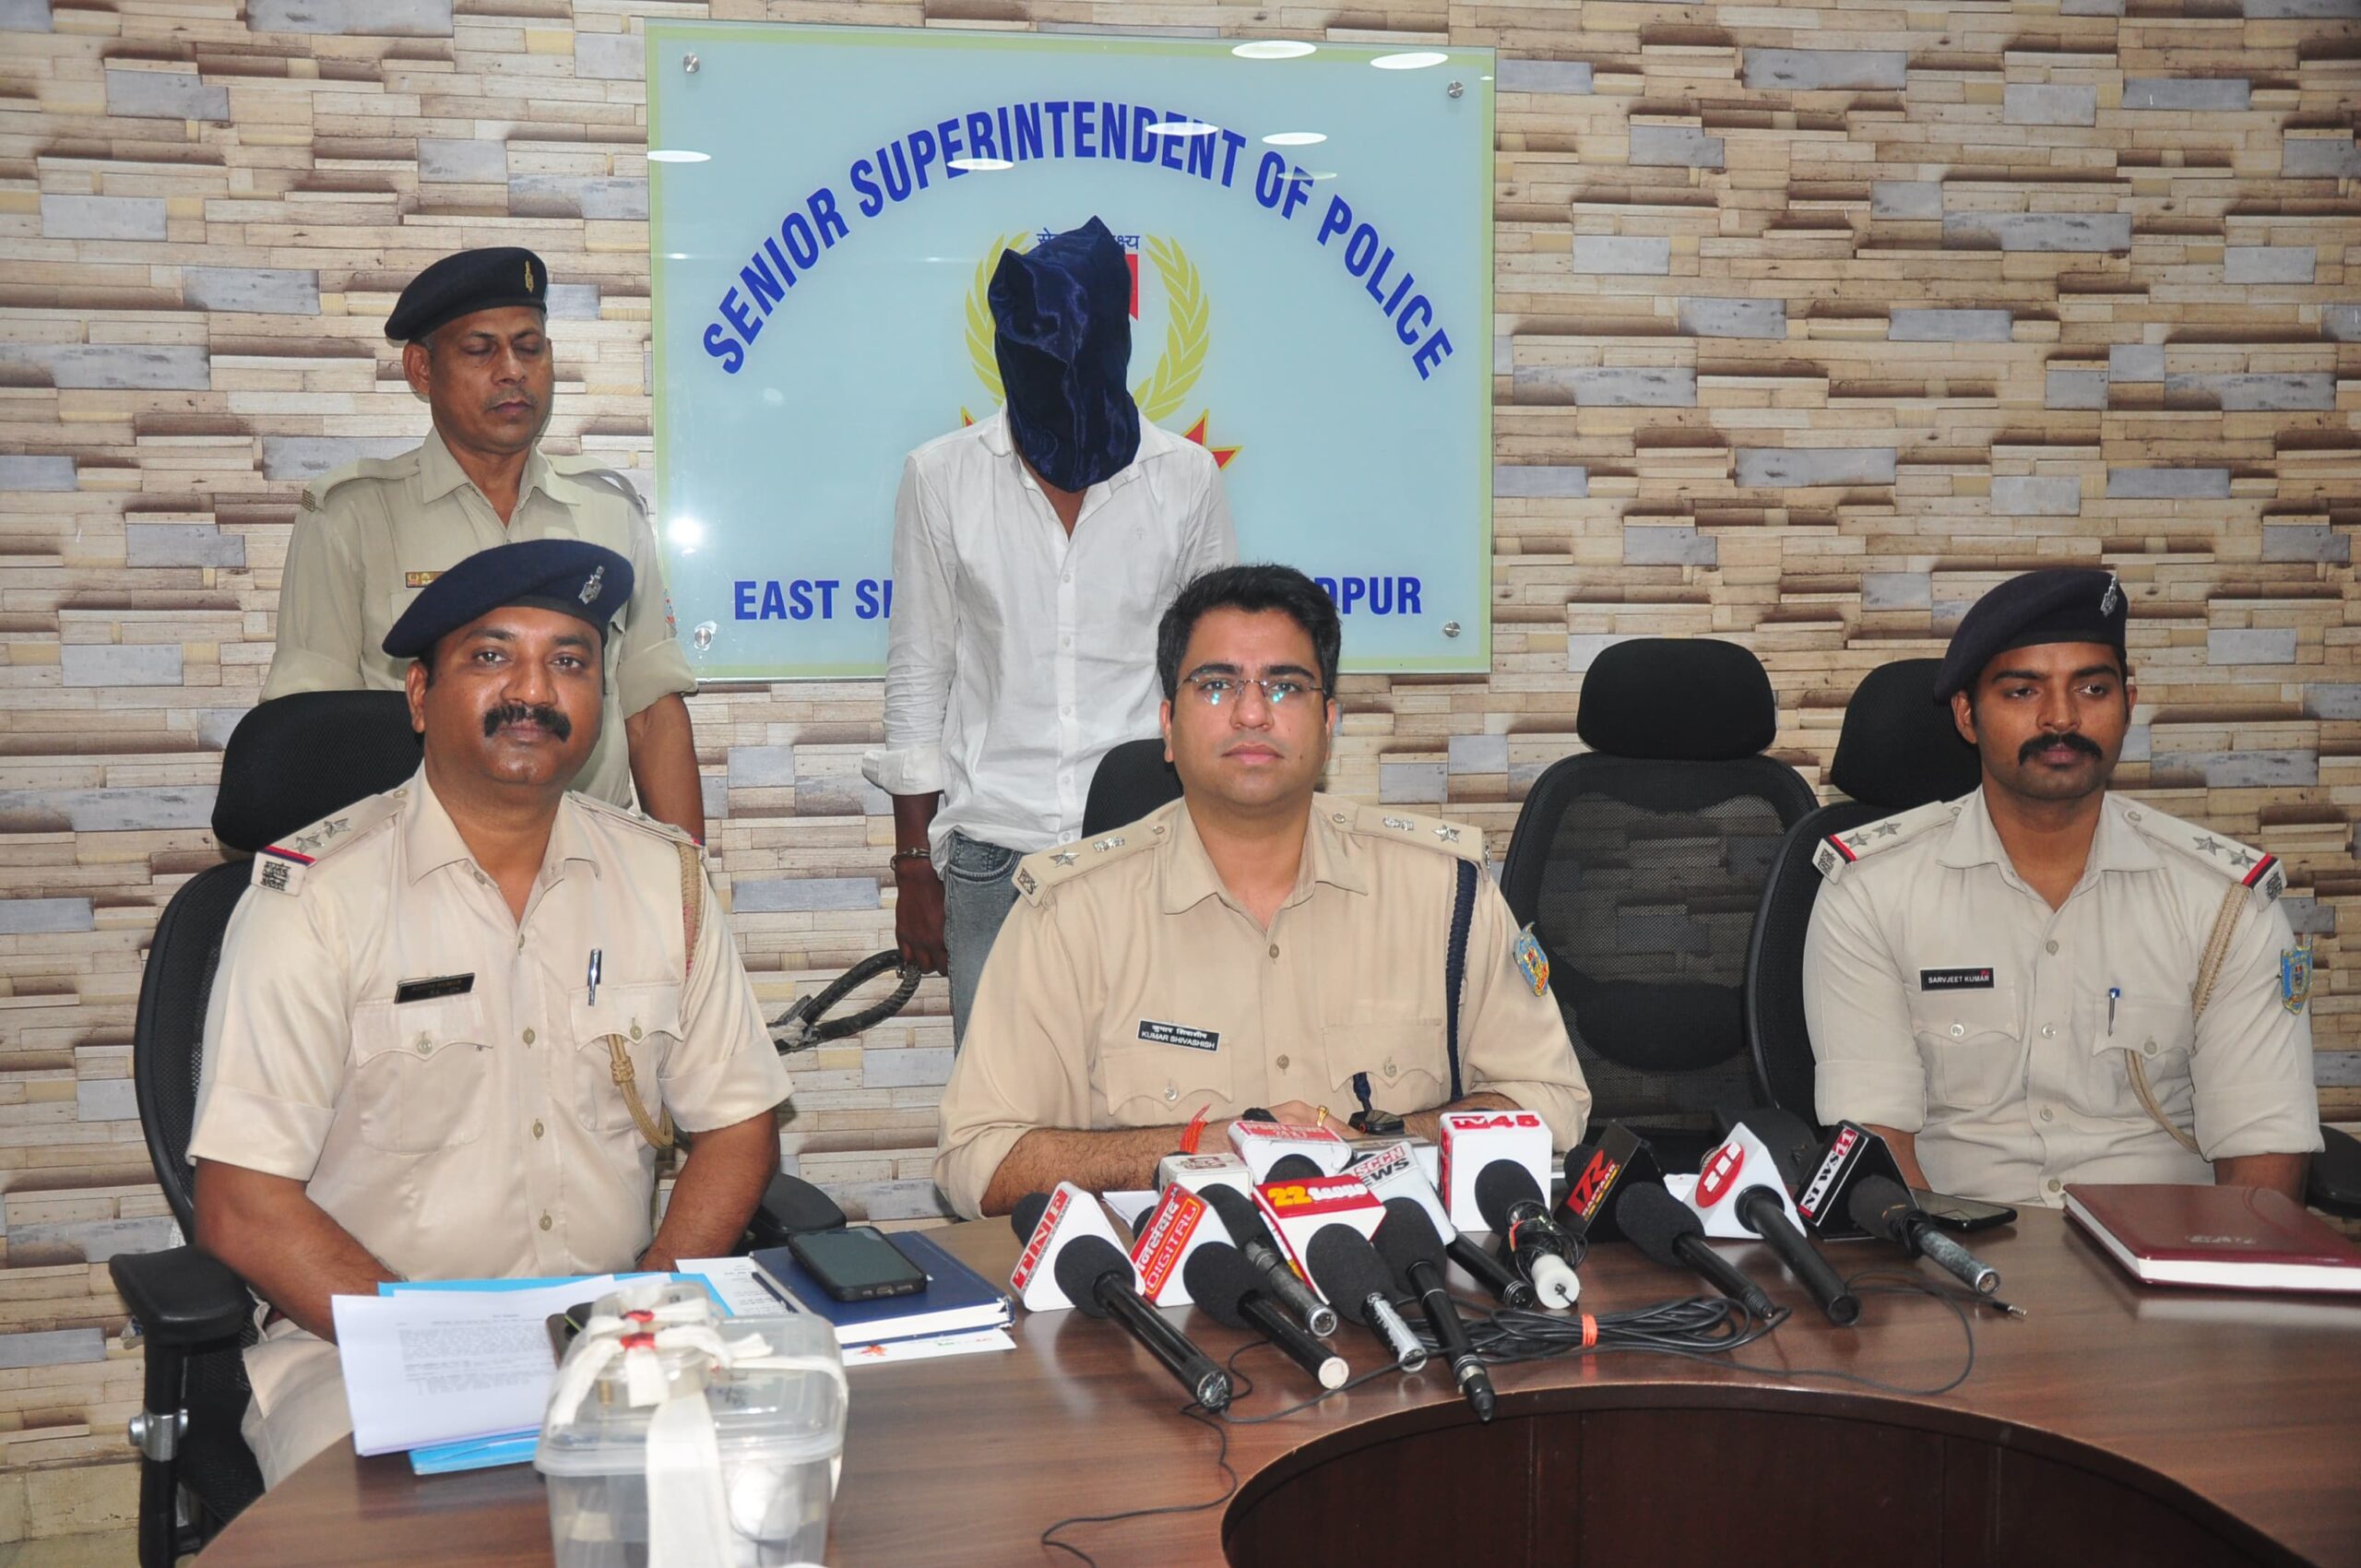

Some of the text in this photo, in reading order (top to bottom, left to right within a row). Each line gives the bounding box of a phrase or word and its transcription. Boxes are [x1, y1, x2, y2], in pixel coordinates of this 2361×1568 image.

[704, 101, 1453, 380] SENIOR SUPERINTENDENT OF POLICE
[734, 576, 1423, 621] EAST SI DPUR
[1964, 974, 1989, 982] KUMAR
[1141, 1031, 1216, 1050] KUMAR SHIVASHISH
[1362, 1158, 1410, 1187] EWS
[1015, 1194, 1061, 1279] TNF
[1135, 1200, 1180, 1271] नसंवाद
[1146, 1206, 1197, 1289] DIGITAL
